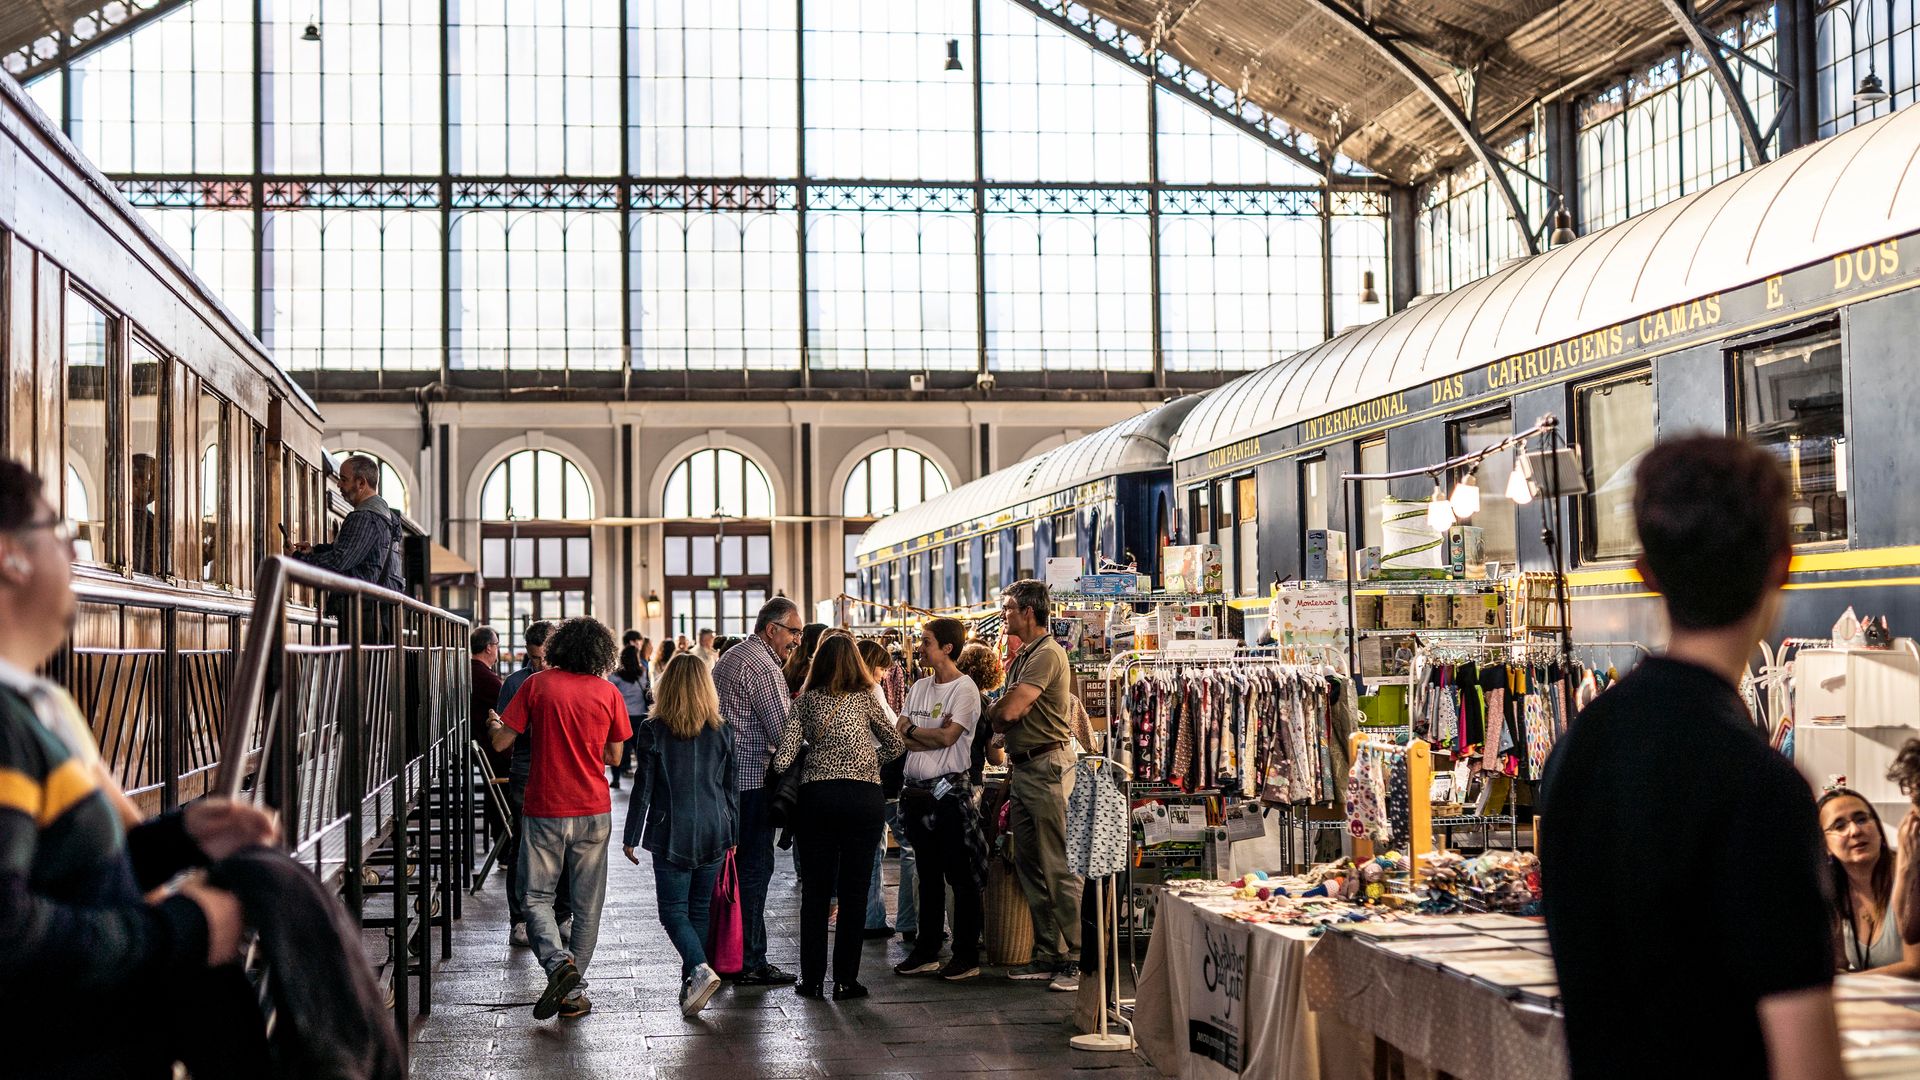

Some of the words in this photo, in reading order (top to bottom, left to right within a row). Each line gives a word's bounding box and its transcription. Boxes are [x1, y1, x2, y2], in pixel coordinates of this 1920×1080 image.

[1208, 437, 1261, 469] COMPANHIA
[1305, 392, 1408, 441] INTERNACIONAL
[1432, 374, 1464, 404] DAS
[1766, 274, 1784, 310] E
[1834, 238, 1900, 290] DOS
[1295, 599, 1338, 609] Montessori
[1086, 682, 1113, 690] ROCA
